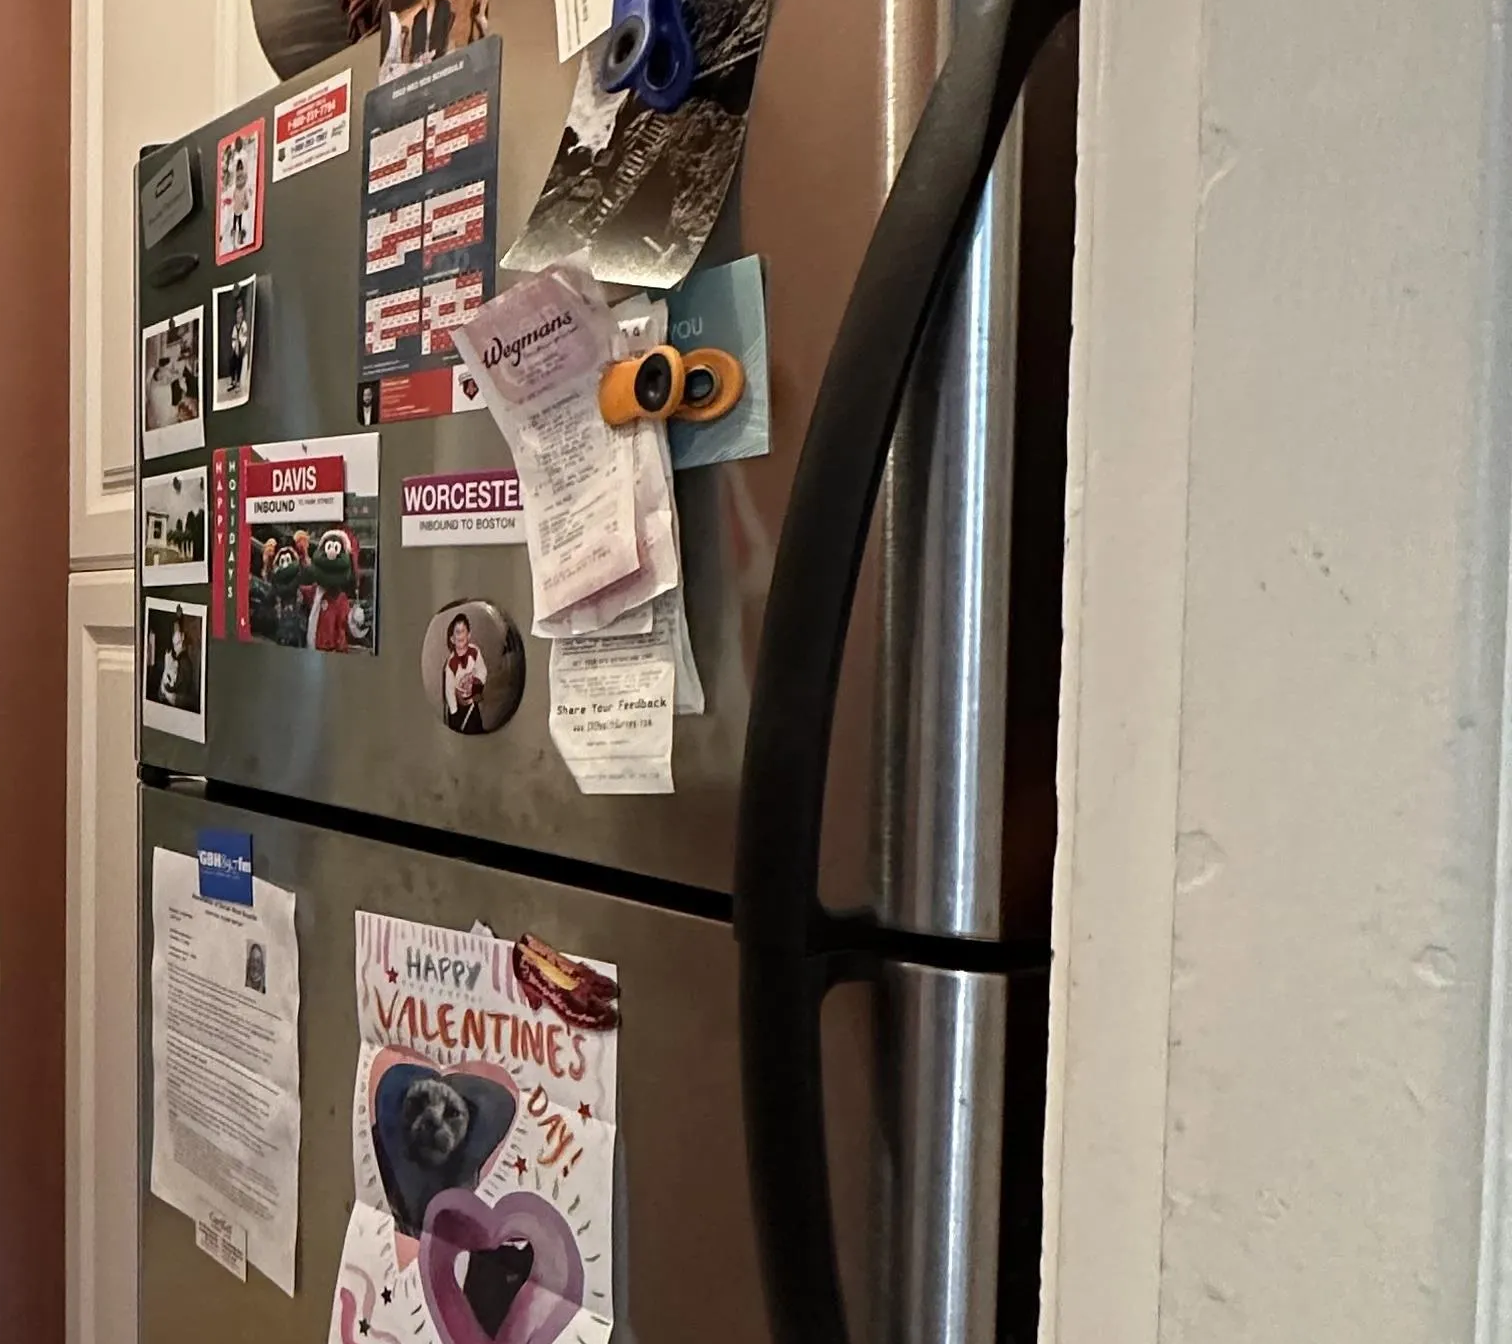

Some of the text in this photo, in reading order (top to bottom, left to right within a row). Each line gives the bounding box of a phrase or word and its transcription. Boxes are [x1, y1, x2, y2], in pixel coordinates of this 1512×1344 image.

[482, 309, 573, 370] Wegmans
[272, 465, 317, 493] DAVIS
[404, 479, 523, 512] WORCESTE
[215, 462, 224, 544] HAPPY
[253, 499, 296, 514] INBOUND
[227, 462, 236, 598] HOLIDAYS
[419, 517, 516, 532] INBOUND TO BOSTON
[556, 696, 668, 716] Share Your Feedback
[406, 945, 482, 991] HAPPY
[374, 986, 587, 1081] VALENTINE'S
